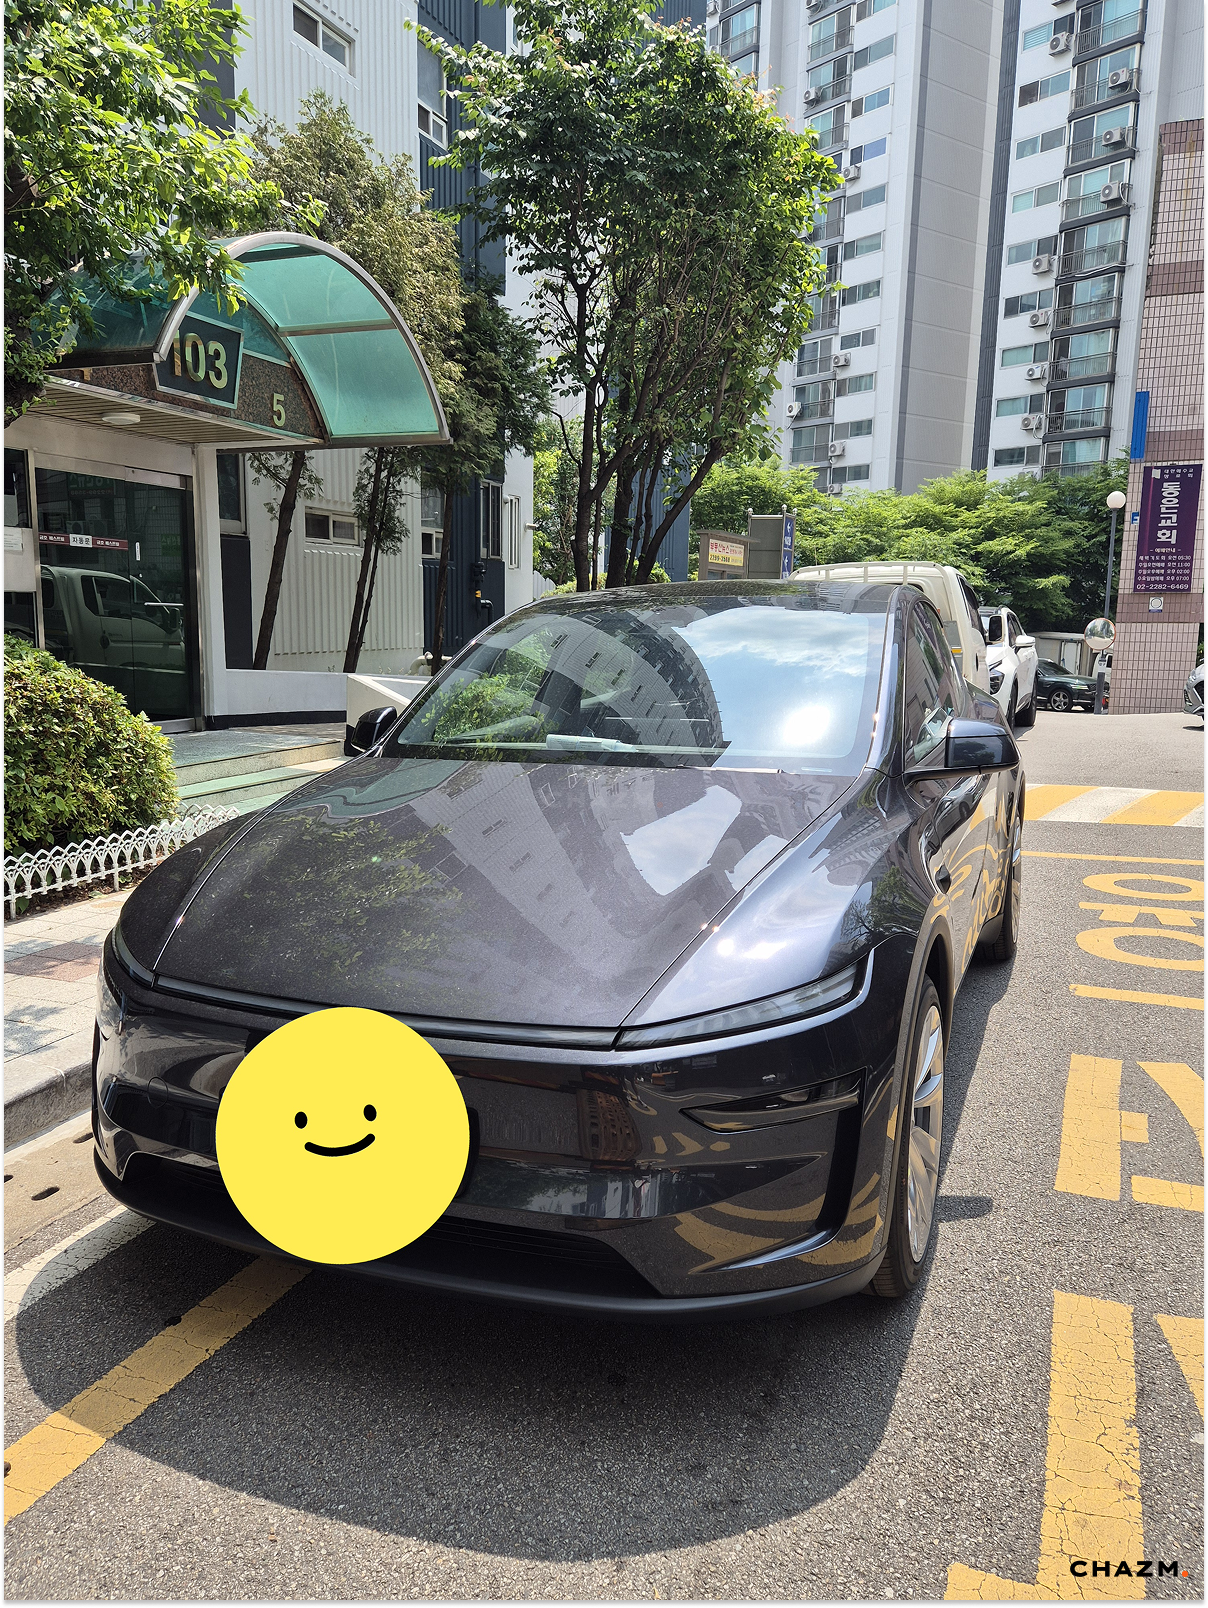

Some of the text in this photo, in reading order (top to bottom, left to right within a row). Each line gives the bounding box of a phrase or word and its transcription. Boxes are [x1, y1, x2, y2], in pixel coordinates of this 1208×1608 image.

[172, 330, 229, 389] 103
[271, 393, 286, 427] 5
[1157, 482, 1181, 545] 동은교회
[72, 536, 90, 545] 자동문
